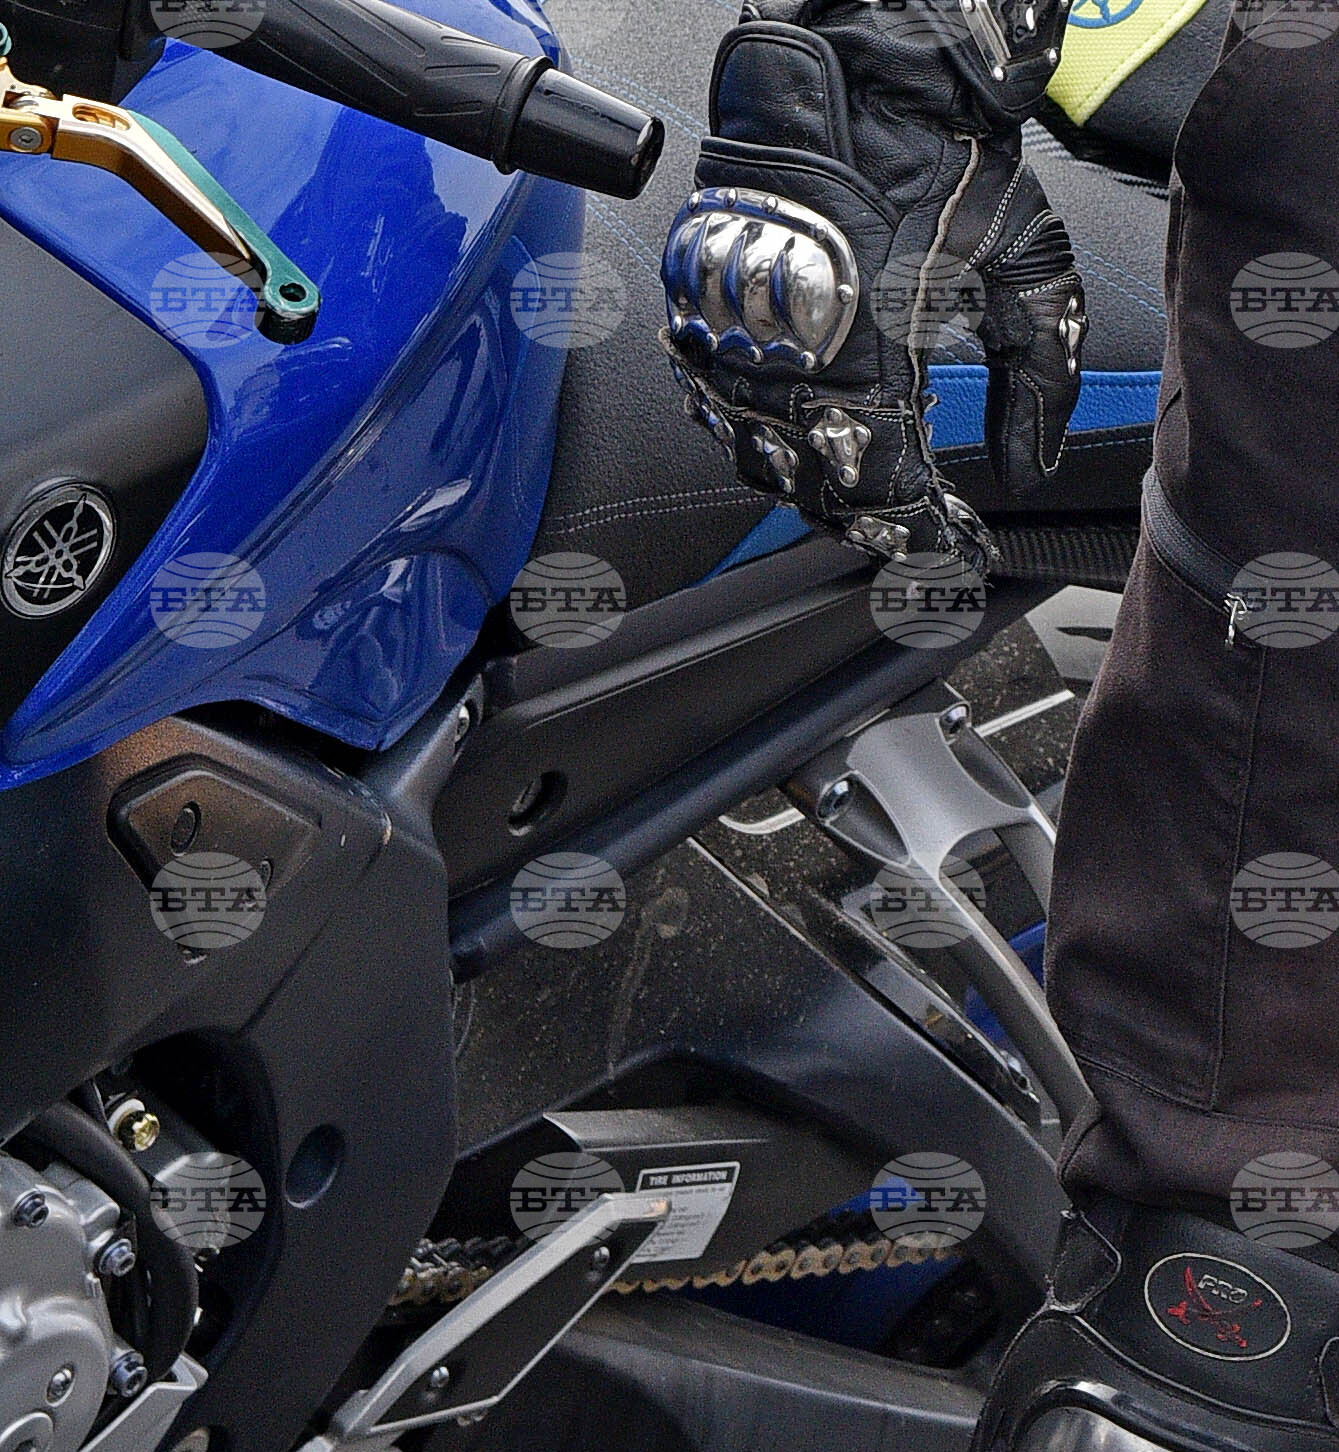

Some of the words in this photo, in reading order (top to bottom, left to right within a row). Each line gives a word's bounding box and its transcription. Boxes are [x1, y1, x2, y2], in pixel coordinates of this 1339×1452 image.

[649, 1175, 669, 1187] TIRE
[671, 1170, 728, 1185] INFORMATION
[1198, 1273, 1248, 1304] PRO
